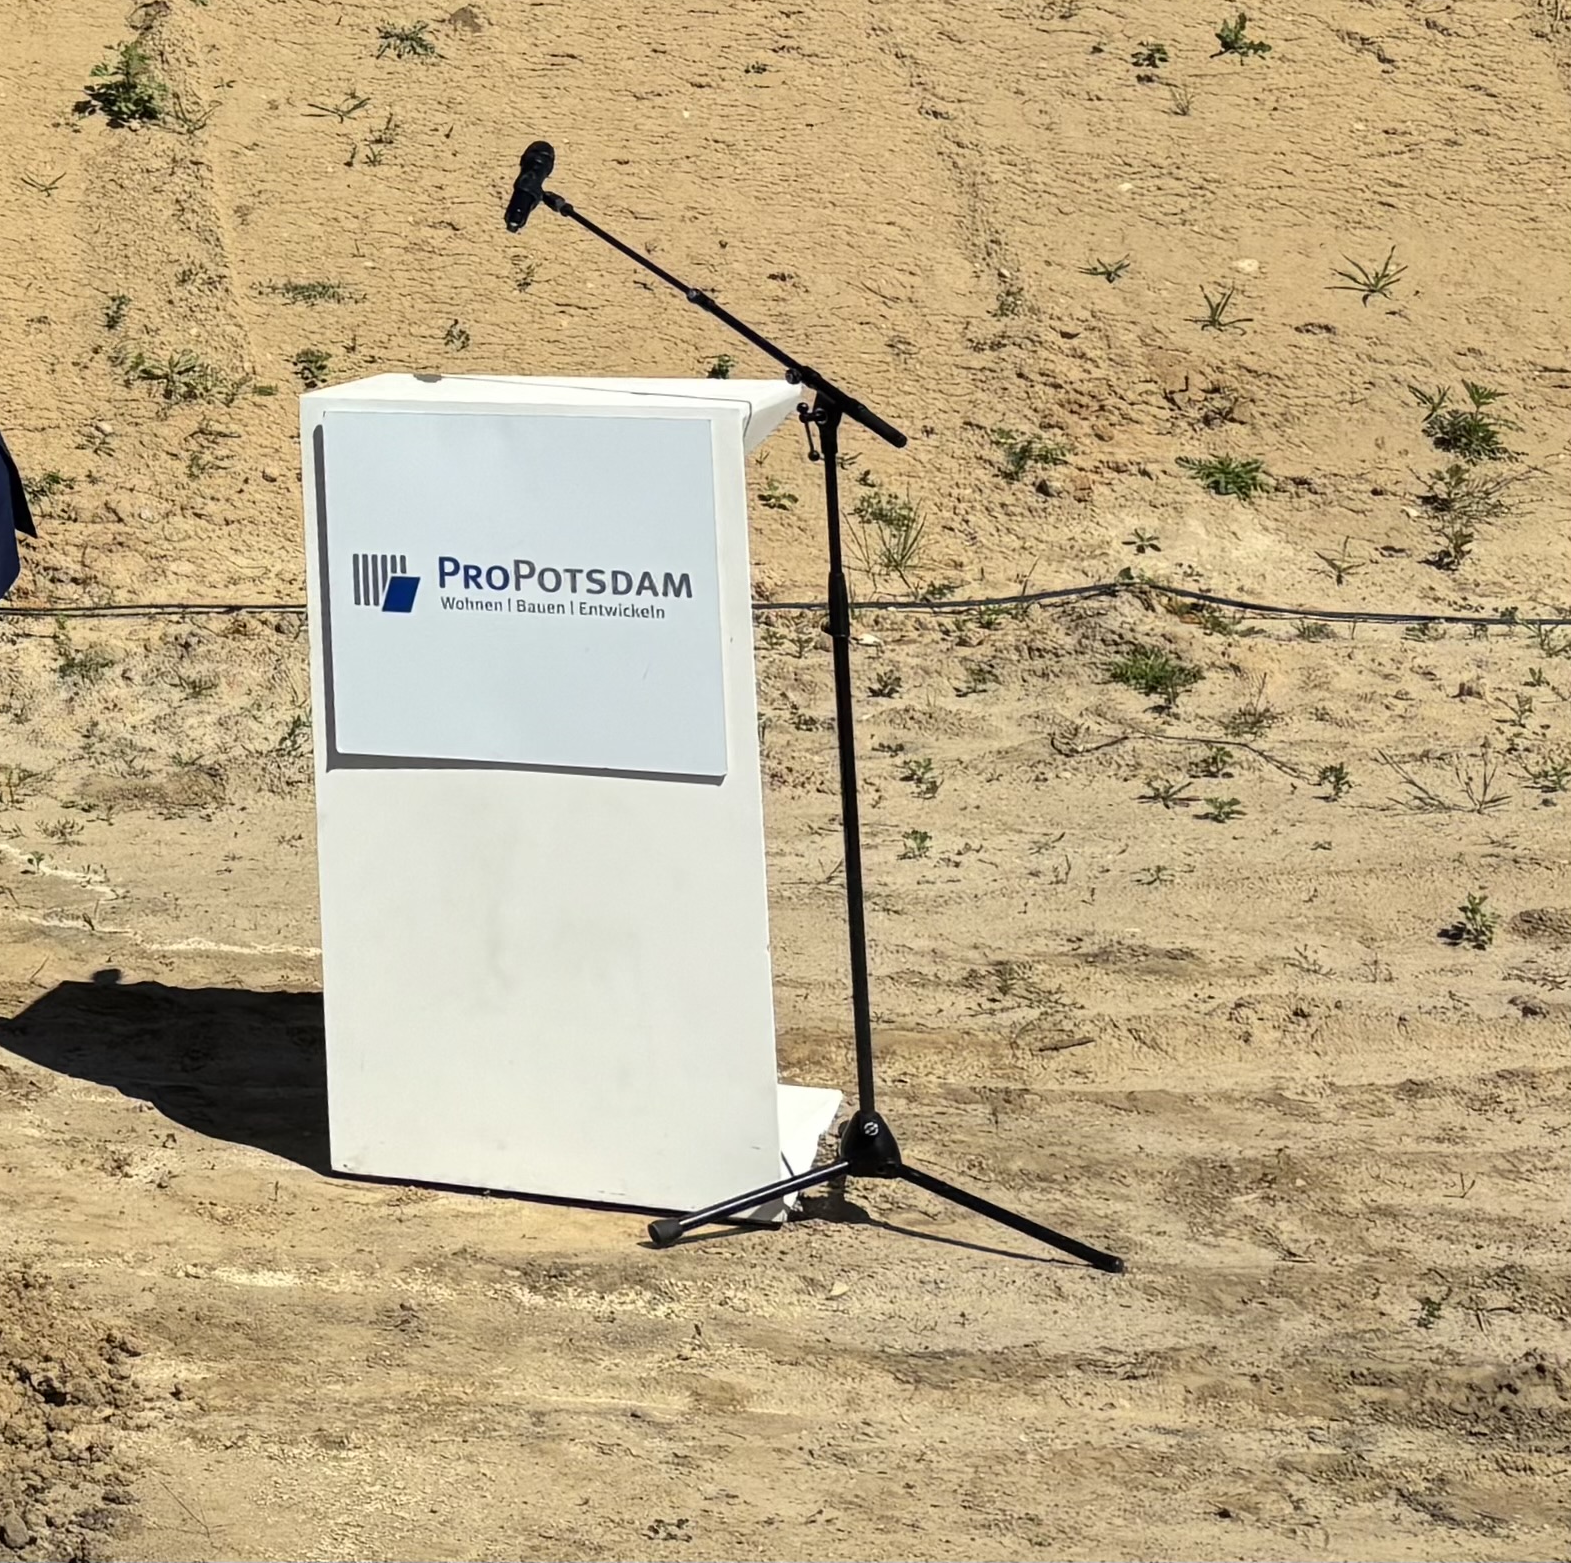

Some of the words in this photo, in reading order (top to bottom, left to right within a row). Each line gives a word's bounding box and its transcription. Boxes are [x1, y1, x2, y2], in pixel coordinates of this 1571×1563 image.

[441, 596, 503, 613] Wohnen
[516, 599, 566, 615] Bauen
[579, 602, 665, 619] Entwickeln
